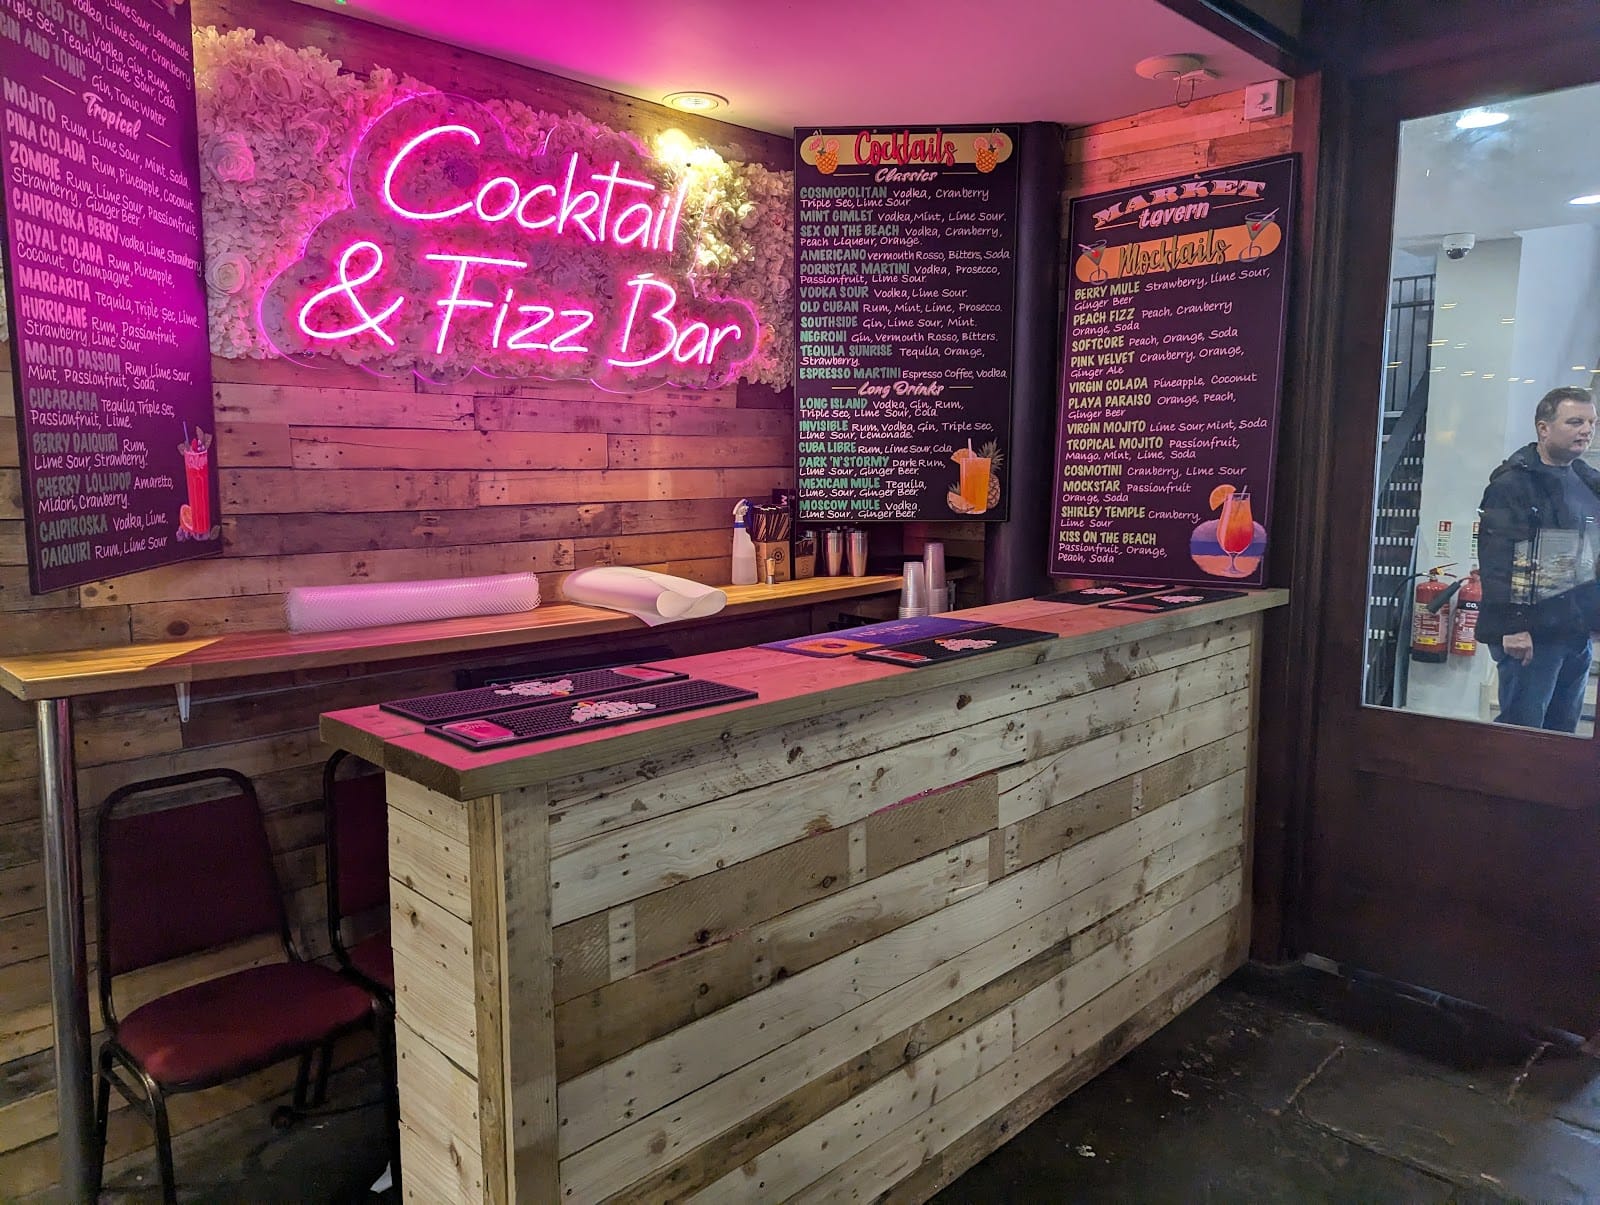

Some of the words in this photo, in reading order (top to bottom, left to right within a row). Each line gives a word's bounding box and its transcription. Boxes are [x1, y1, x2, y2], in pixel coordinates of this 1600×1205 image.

[3, 77, 56, 122] MOJITO
[92, 131, 117, 152] Lime
[82, 92, 141, 140] Tropical
[854, 129, 958, 166] Cocktails
[874, 168, 938, 183] Classics
[383, 124, 689, 253] Cocktail
[800, 186, 887, 198] COSMOPOLITAN
[936, 188, 989, 201] Cranberry
[1092, 180, 1266, 227] MARKET
[800, 210, 830, 222] MINT
[833, 209, 873, 221] GIMLET
[949, 212, 976, 221] Lime
[1139, 202, 1209, 229] tavern
[800, 225, 820, 237] SEX
[824, 225, 839, 236] ON
[842, 224, 862, 236] THE
[864, 225, 899, 236] BEACH
[15, 219, 58, 251] ROYAL
[61, 233, 103, 266] COLADA
[800, 238, 828, 246] Peach
[1118, 229, 1232, 279] Mocktails
[800, 263, 857, 275] PORNSTAR
[861, 263, 910, 274] MARTINI
[1075, 285, 1108, 300] BERRY
[1110, 281, 1140, 297] MULE
[1211, 271, 1236, 283] Lime
[19, 265, 91, 302] MARGARITA
[135, 298, 158, 323] Triple
[299, 242, 404, 345] &
[426, 254, 595, 354] Fizz
[607, 273, 741, 368] Bar
[800, 302, 820, 313] OLD
[823, 301, 859, 313] CUBAN
[1075, 299, 1109, 311] Ginger
[1112, 295, 1134, 307] Beer
[21, 295, 87, 328] HURRICANE
[1073, 310, 1107, 326] PEACH
[1109, 308, 1136, 322] FIZZ
[1177, 301, 1233, 315] Cranberry
[800, 316, 858, 328] SOUTHSIDE
[888, 318, 914, 327] Lime
[1113, 322, 1140, 332] Soda
[800, 331, 847, 342] NEGRONI
[875, 333, 924, 342] Vermouth
[1071, 336, 1125, 352] SOFTCORE
[1208, 328, 1238, 339] Soda
[800, 346, 845, 357] TEQUILA
[849, 345, 893, 356] SUNRISE
[1071, 354, 1095, 367] PINK
[1098, 351, 1135, 365] VELVET
[1071, 367, 1103, 378] Ginger
[1106, 366, 1124, 375] Ale
[858, 381, 891, 398] Long
[893, 381, 945, 396] Drinks
[1069, 380, 1103, 393] VIRGIN
[1106, 377, 1148, 390] COLADA
[1211, 373, 1257, 384] Coconut
[1068, 397, 1101, 409] PLAYA
[1105, 394, 1152, 407] PARAISO
[1068, 410, 1102, 421] Ginger
[1105, 409, 1126, 418] Beer
[32, 432, 70, 454] BERRY
[73, 432, 119, 451] DAIQUIRI
[1066, 437, 1115, 451] TROPICAL
[1119, 436, 1163, 449] MOJITO
[1064, 464, 1122, 476] COSMOTINI
[1186, 467, 1214, 475] Lime
[1218, 466, 1247, 475] Sour
[37, 474, 81, 498] CHERRY
[85, 472, 131, 495] LOLLIPOP
[1063, 480, 1120, 492] MOCKSTAR
[1127, 483, 1191, 493] Passionfruit
[1103, 493, 1128, 502] Soda
[799, 500, 848, 511] MOSCOW
[850, 500, 880, 510] MULE
[1061, 506, 1102, 518] SHIRLEY
[1104, 506, 1145, 518] TEMPLE
[799, 510, 825, 518] Lime
[858, 510, 895, 520] Ginger
[39, 514, 108, 542] CAIPIROSKA
[1061, 519, 1085, 527] Lime
[1089, 519, 1113, 528] Sour
[1060, 531, 1081, 542] KISS
[1083, 531, 1097, 542] ON
[1100, 532, 1119, 544] THE
[1122, 532, 1156, 545] BEACH
[42, 541, 91, 569] DAIQUIRI
[124, 538, 146, 554] Lime
[148, 537, 167, 549] Sour
[1089, 554, 1115, 563] Soda
